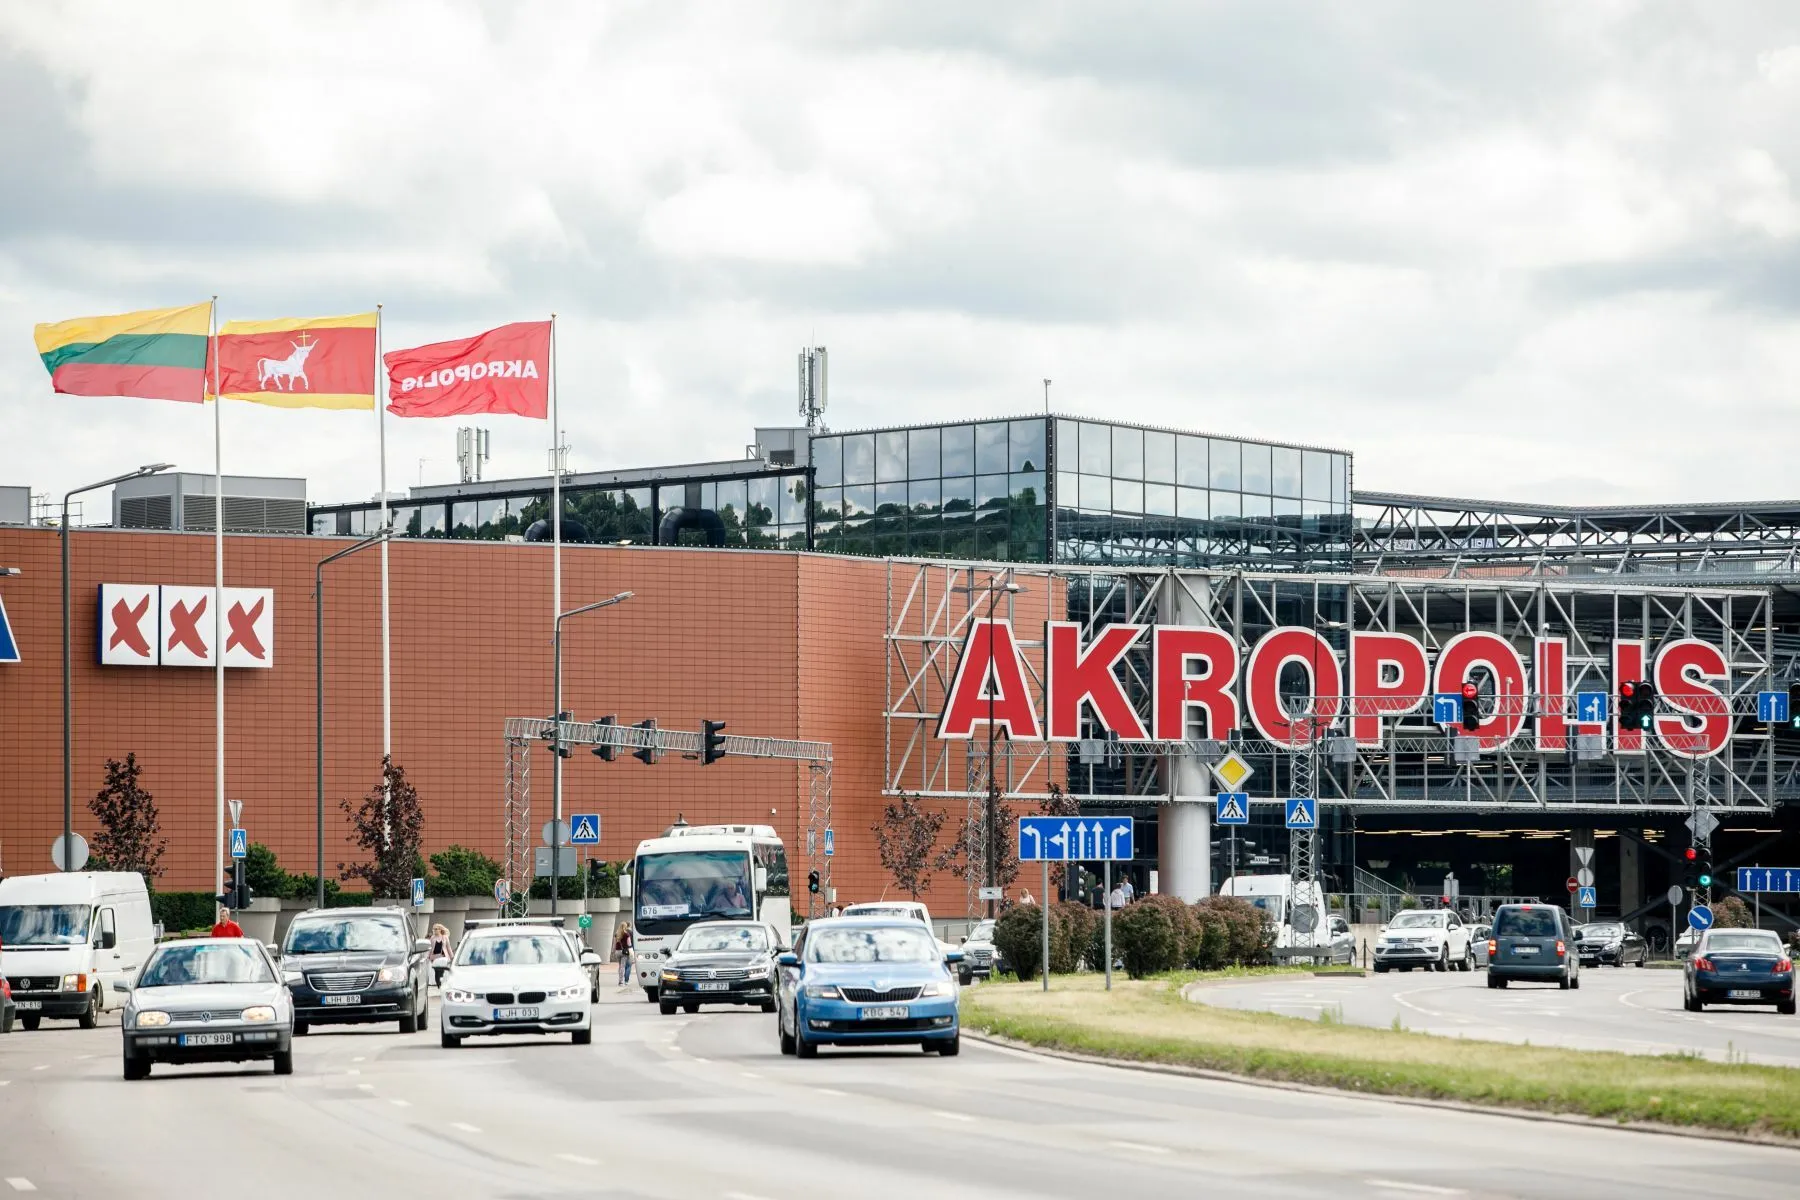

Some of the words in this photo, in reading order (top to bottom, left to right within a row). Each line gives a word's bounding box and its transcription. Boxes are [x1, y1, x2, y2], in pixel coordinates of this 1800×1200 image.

[937, 617, 1734, 760] AKROPOLIS
[642, 906, 658, 915] 676
[325, 995, 342, 1004] LHH
[346, 995, 360, 1003] 882
[499, 1009, 517, 1018] LJH
[522, 1008, 538, 1017] 033
[863, 1008, 884, 1017] KBG
[889, 1007, 907, 1017] 547
[186, 1034, 207, 1044] FTO
[213, 1033, 231, 1043] 998
